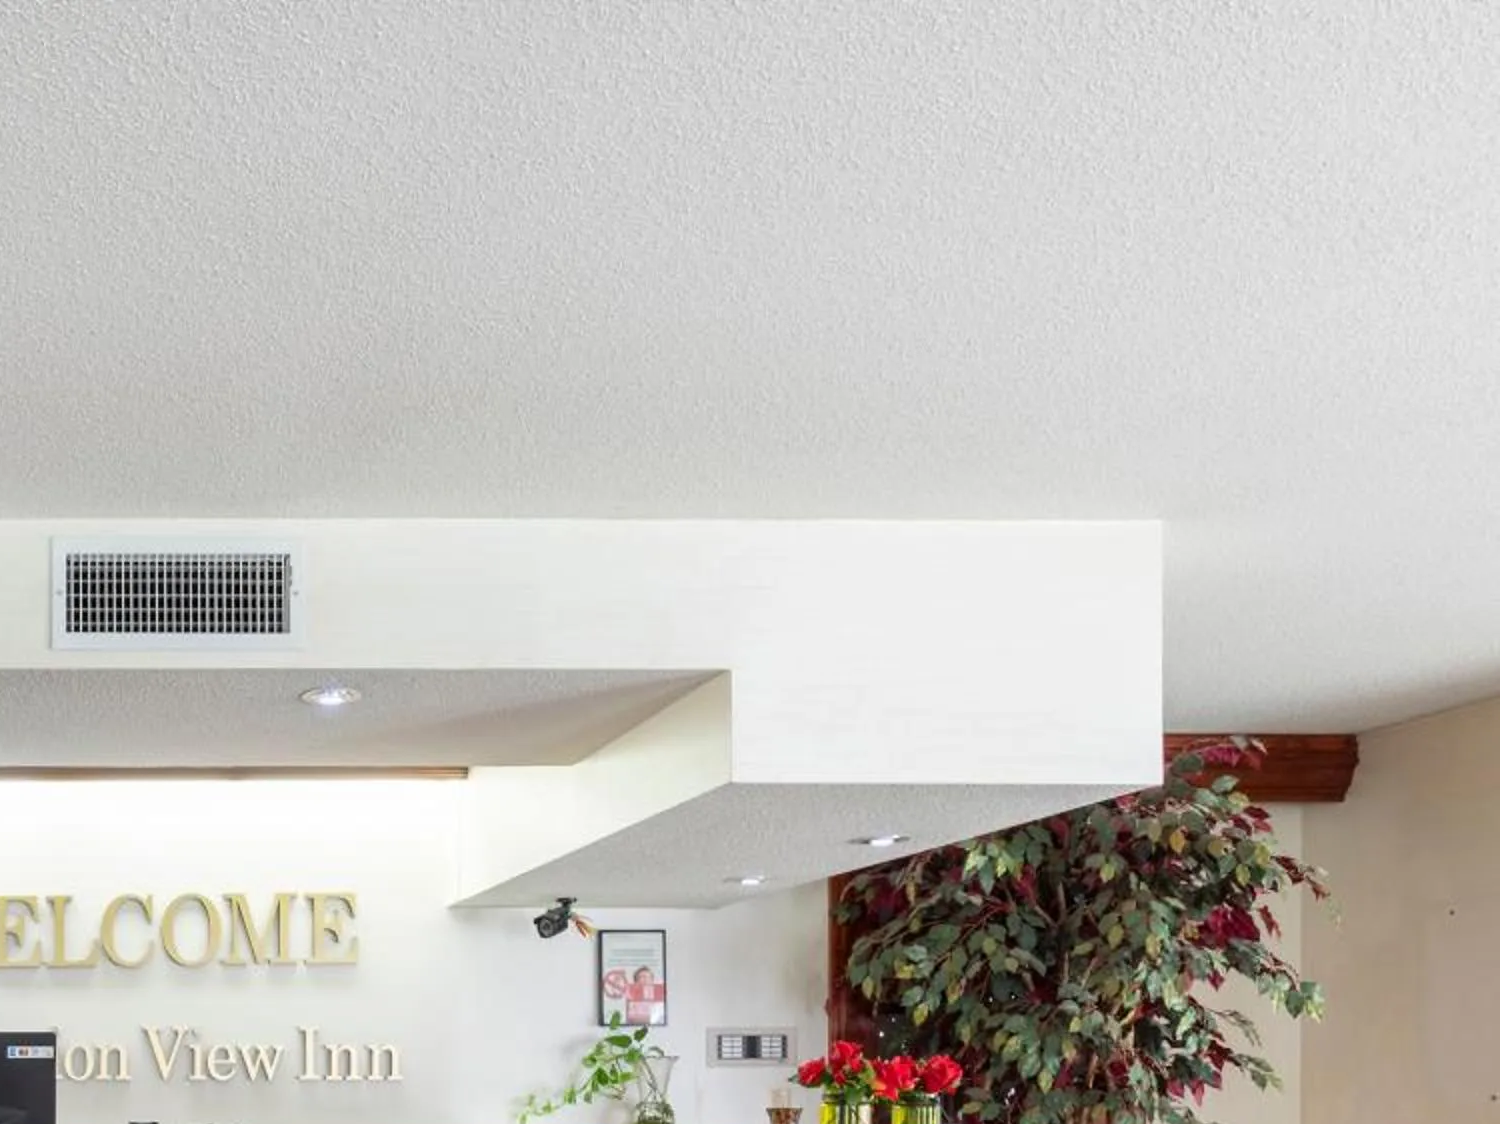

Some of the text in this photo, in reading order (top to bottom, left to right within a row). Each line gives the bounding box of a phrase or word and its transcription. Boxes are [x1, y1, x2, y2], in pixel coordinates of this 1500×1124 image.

[56, 1025, 404, 1083] on View Inn
